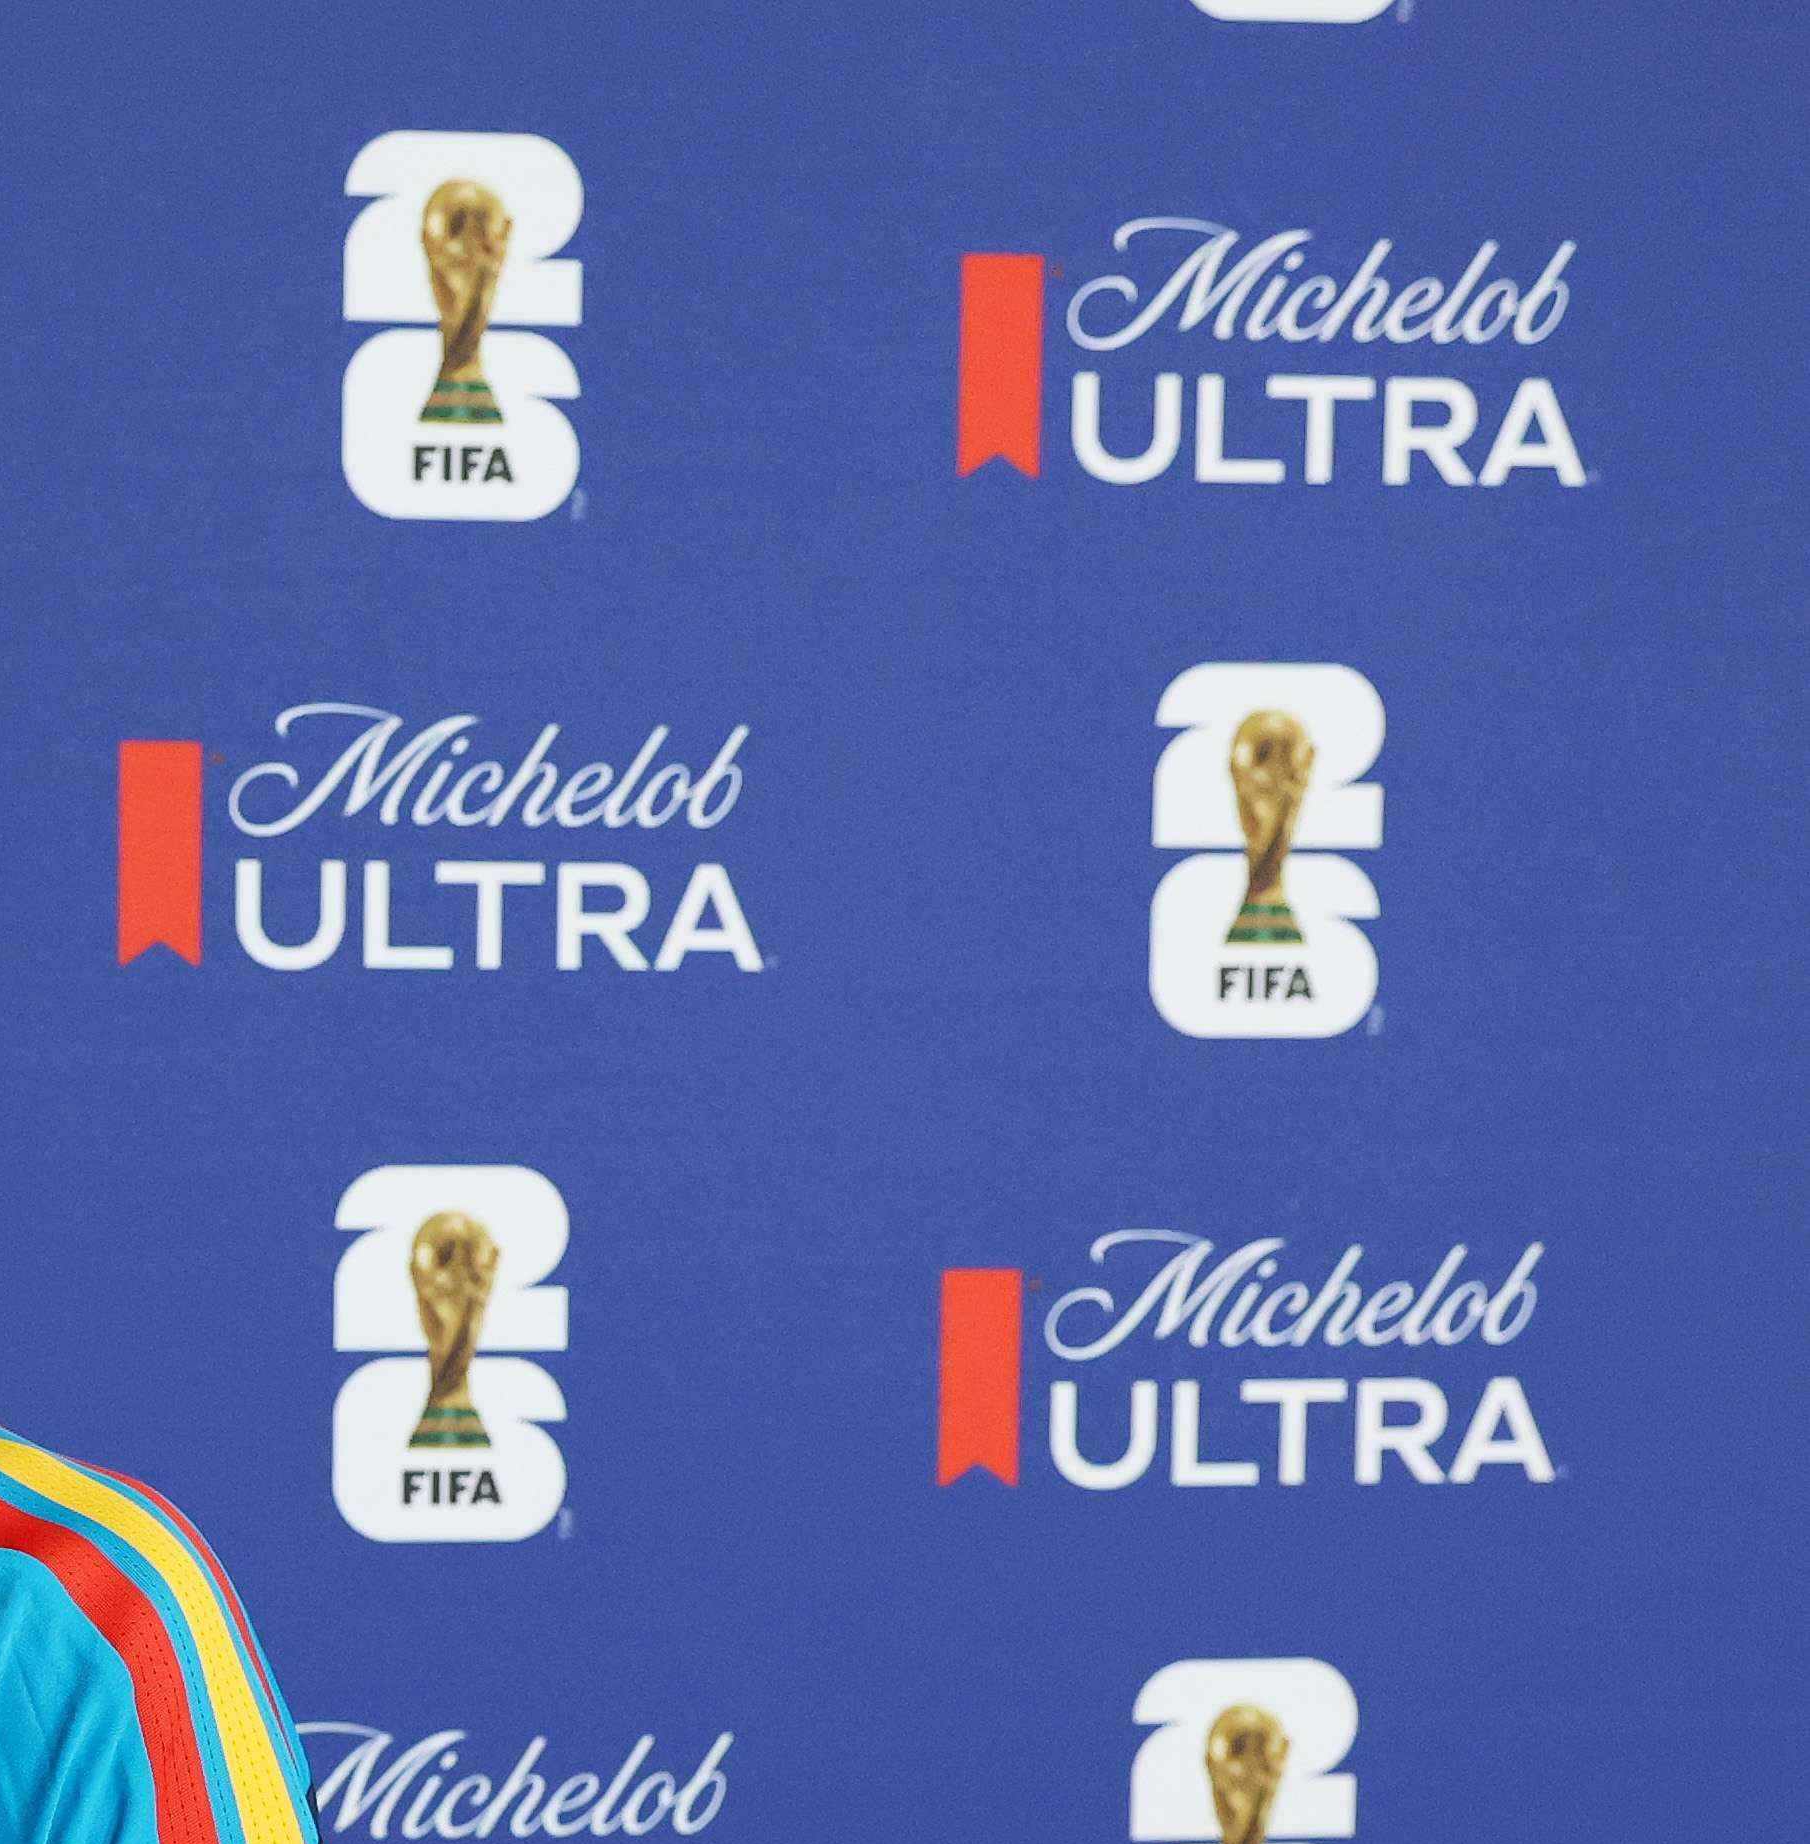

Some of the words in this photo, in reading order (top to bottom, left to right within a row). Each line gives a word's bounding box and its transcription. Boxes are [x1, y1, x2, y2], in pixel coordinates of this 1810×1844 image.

[1068, 219, 1575, 350] Michelob
[413, 446, 512, 482] FIFA
[1072, 372, 1586, 486] ULTRA
[230, 704, 748, 836] Michelob
[236, 859, 763, 971] ULTRA
[1218, 967, 1312, 999] FIFA
[1046, 1231, 1543, 1360] Michelob
[402, 1470, 500, 1504] FIFA
[1050, 1378, 1555, 1489] ULTRA
